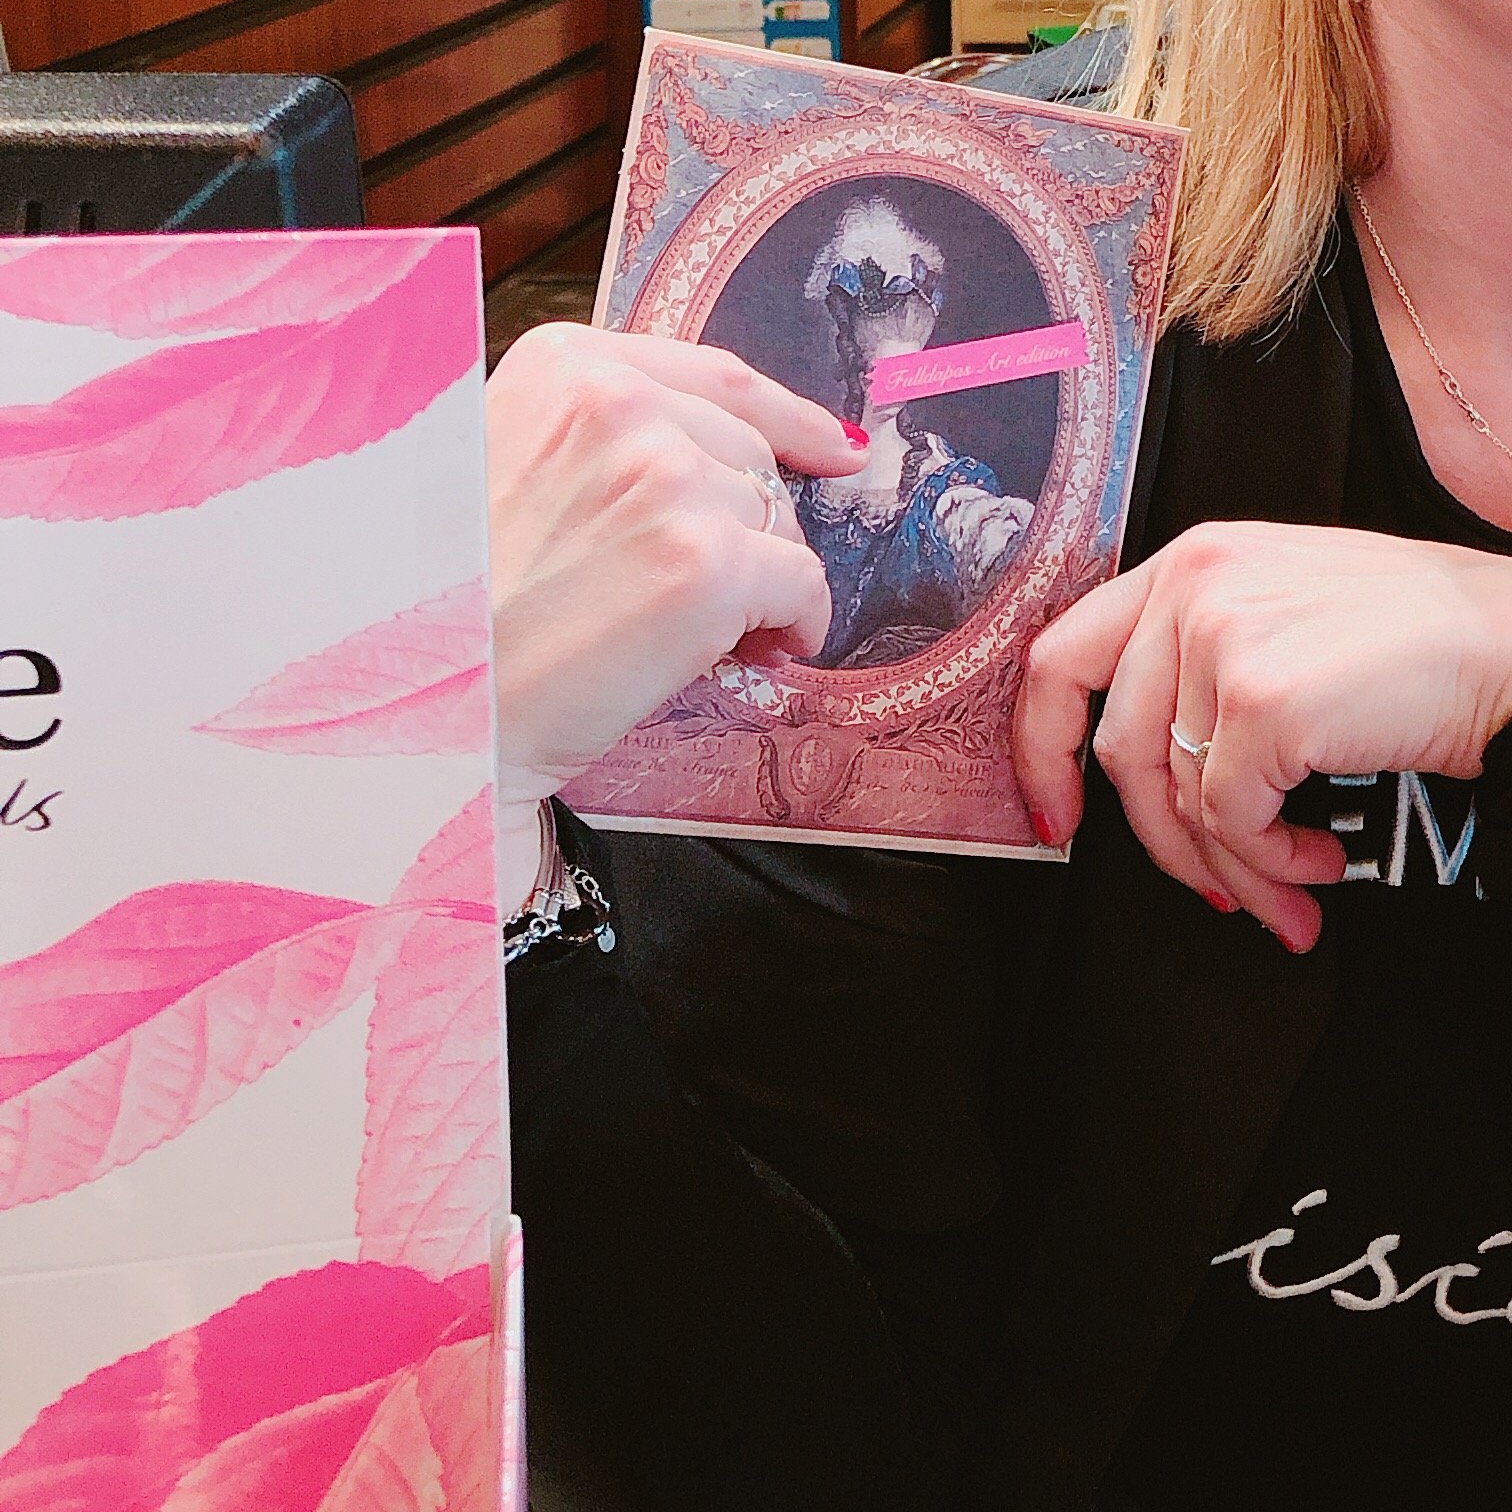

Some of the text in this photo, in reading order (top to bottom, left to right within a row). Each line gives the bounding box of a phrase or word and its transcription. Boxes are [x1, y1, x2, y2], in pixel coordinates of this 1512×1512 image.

[885, 344, 1072, 392] Fulldapas Art edition
